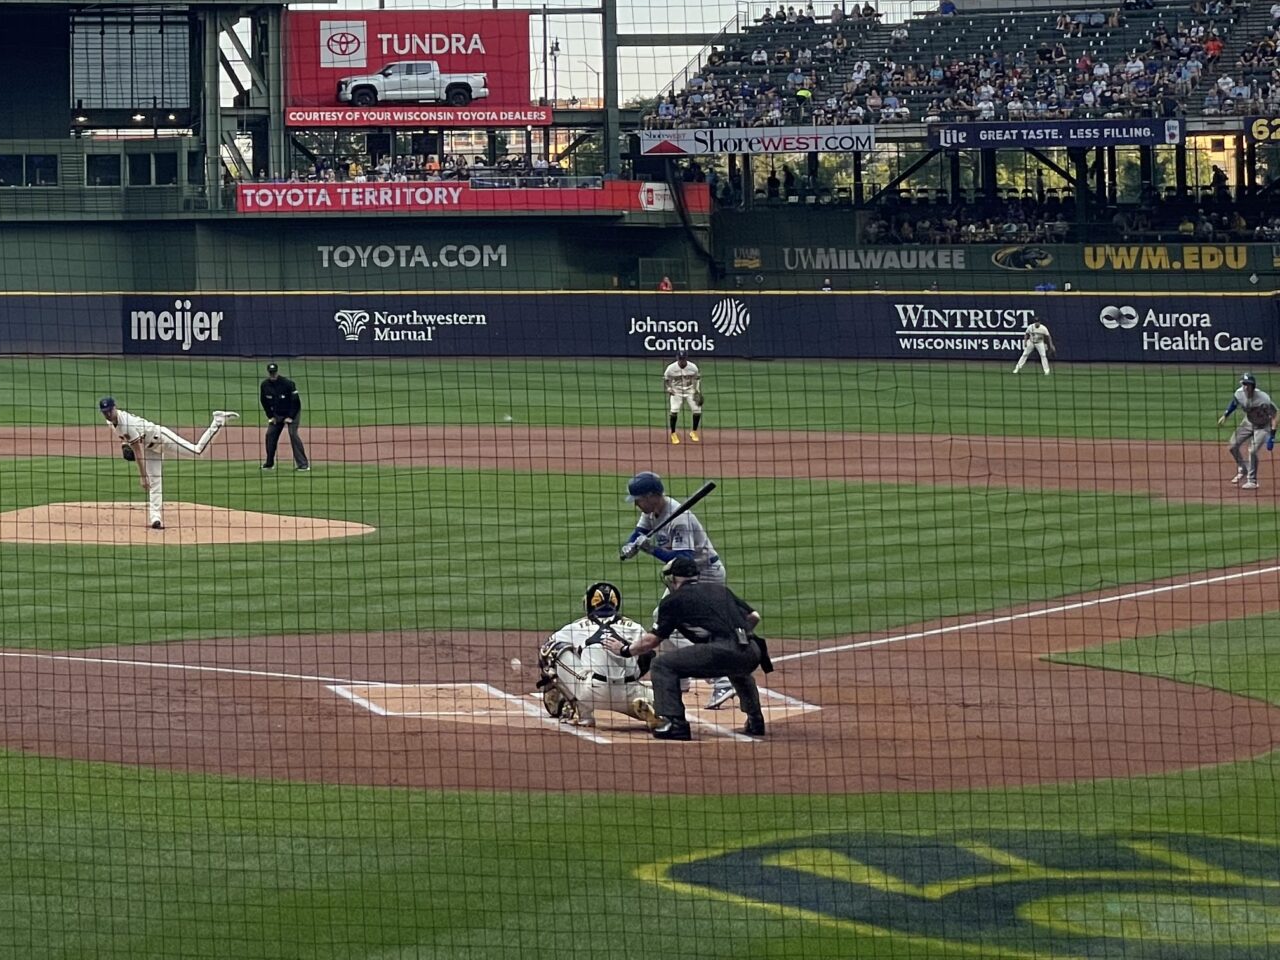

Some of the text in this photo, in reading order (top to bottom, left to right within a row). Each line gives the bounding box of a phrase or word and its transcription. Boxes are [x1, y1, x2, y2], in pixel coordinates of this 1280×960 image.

[377, 33, 486, 54] TUNDRA
[289, 111, 546, 121] COURTESY OF YOUR WISCONSIN TOYOTA DEALERS
[979, 129, 1020, 140] GREAT
[1022, 128, 1063, 140] TASTE.
[1069, 128, 1100, 139] LESS
[1103, 127, 1155, 139] FILLING.
[244, 186, 464, 208] TOYOTA TERRITORY
[317, 244, 507, 269] TOYOTA.COM
[783, 247, 965, 270] UWMILWAUKEE
[1084, 245, 1247, 270] UWM.EDU
[130, 300, 223, 351] meijer
[374, 311, 487, 326] Northwestern
[629, 316, 699, 335] Johnson
[895, 304, 1035, 329] WINTRUST
[1143, 308, 1212, 327] Aurora
[374, 327, 433, 342] Mutual
[644, 335, 714, 352] Controls
[900, 338, 1026, 351] WISCONSIN'S BAN
[1143, 331, 1264, 352] Health Care
